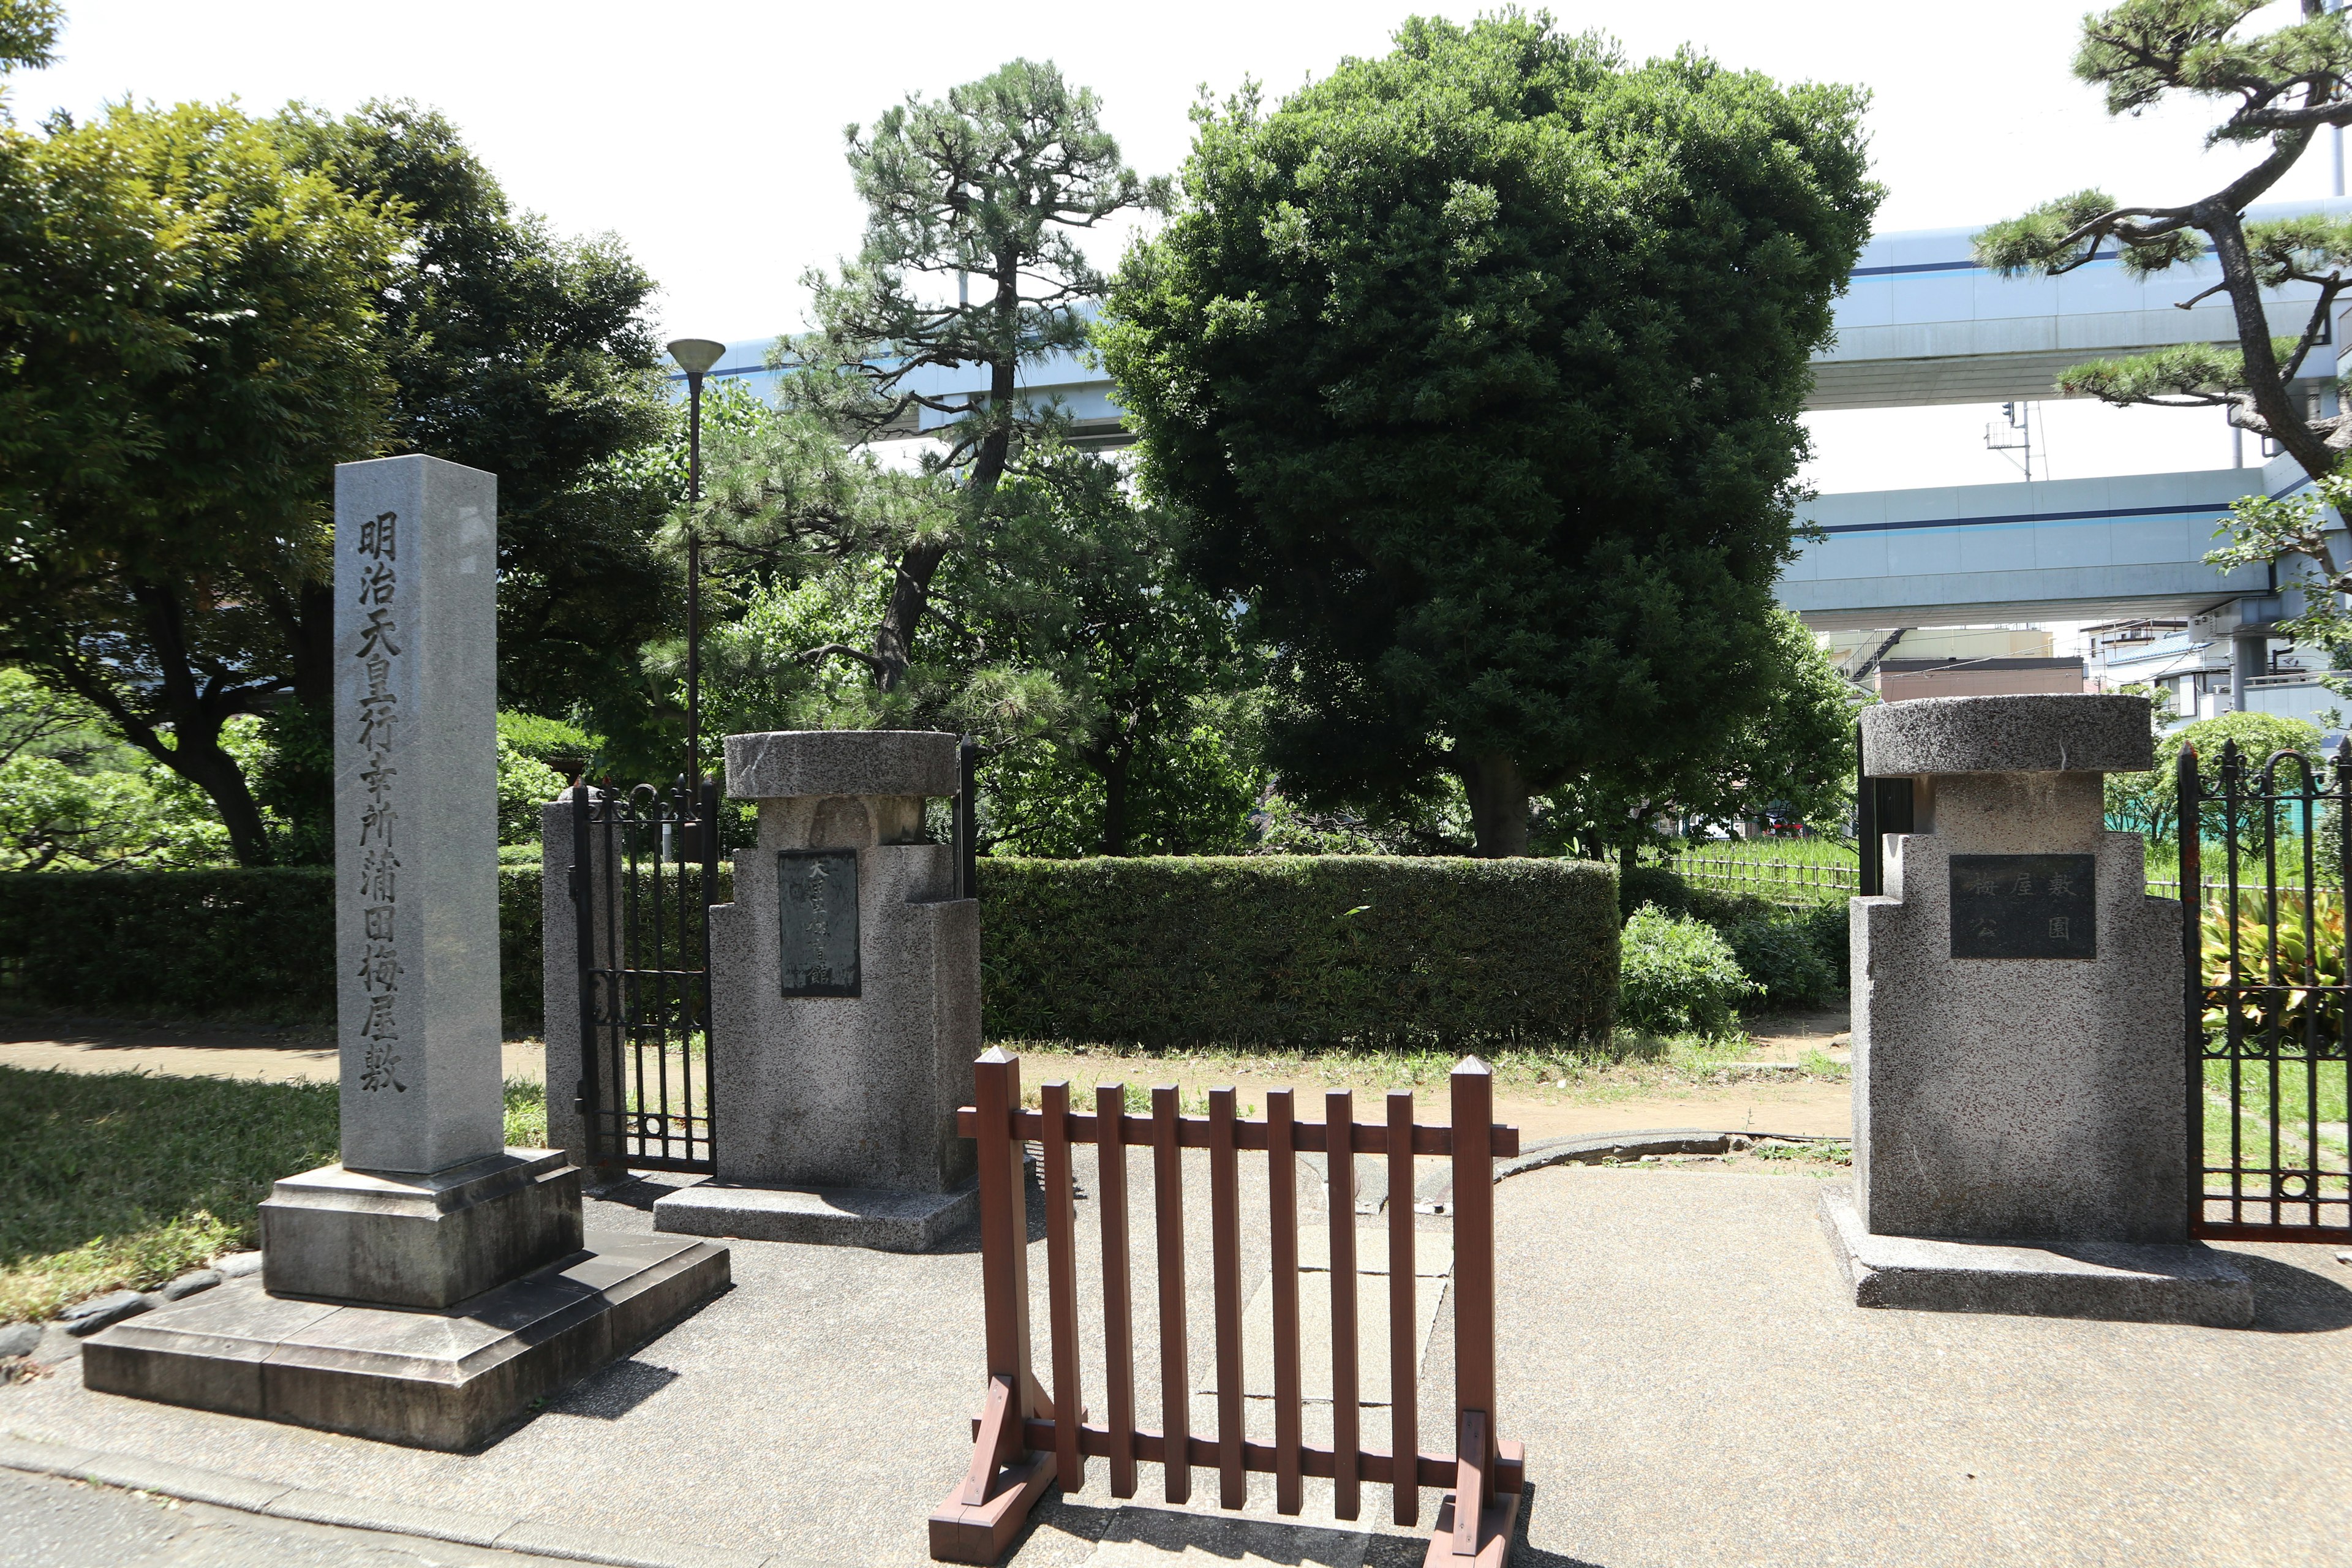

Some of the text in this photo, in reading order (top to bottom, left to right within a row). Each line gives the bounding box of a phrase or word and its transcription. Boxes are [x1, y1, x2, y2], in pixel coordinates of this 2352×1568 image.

[355, 511, 407, 1093] 明治天皇行幸所蒲田梅屋敷
[1968, 872, 2078, 897] 梅屋敷
[1973, 916, 2070, 941] 公園
